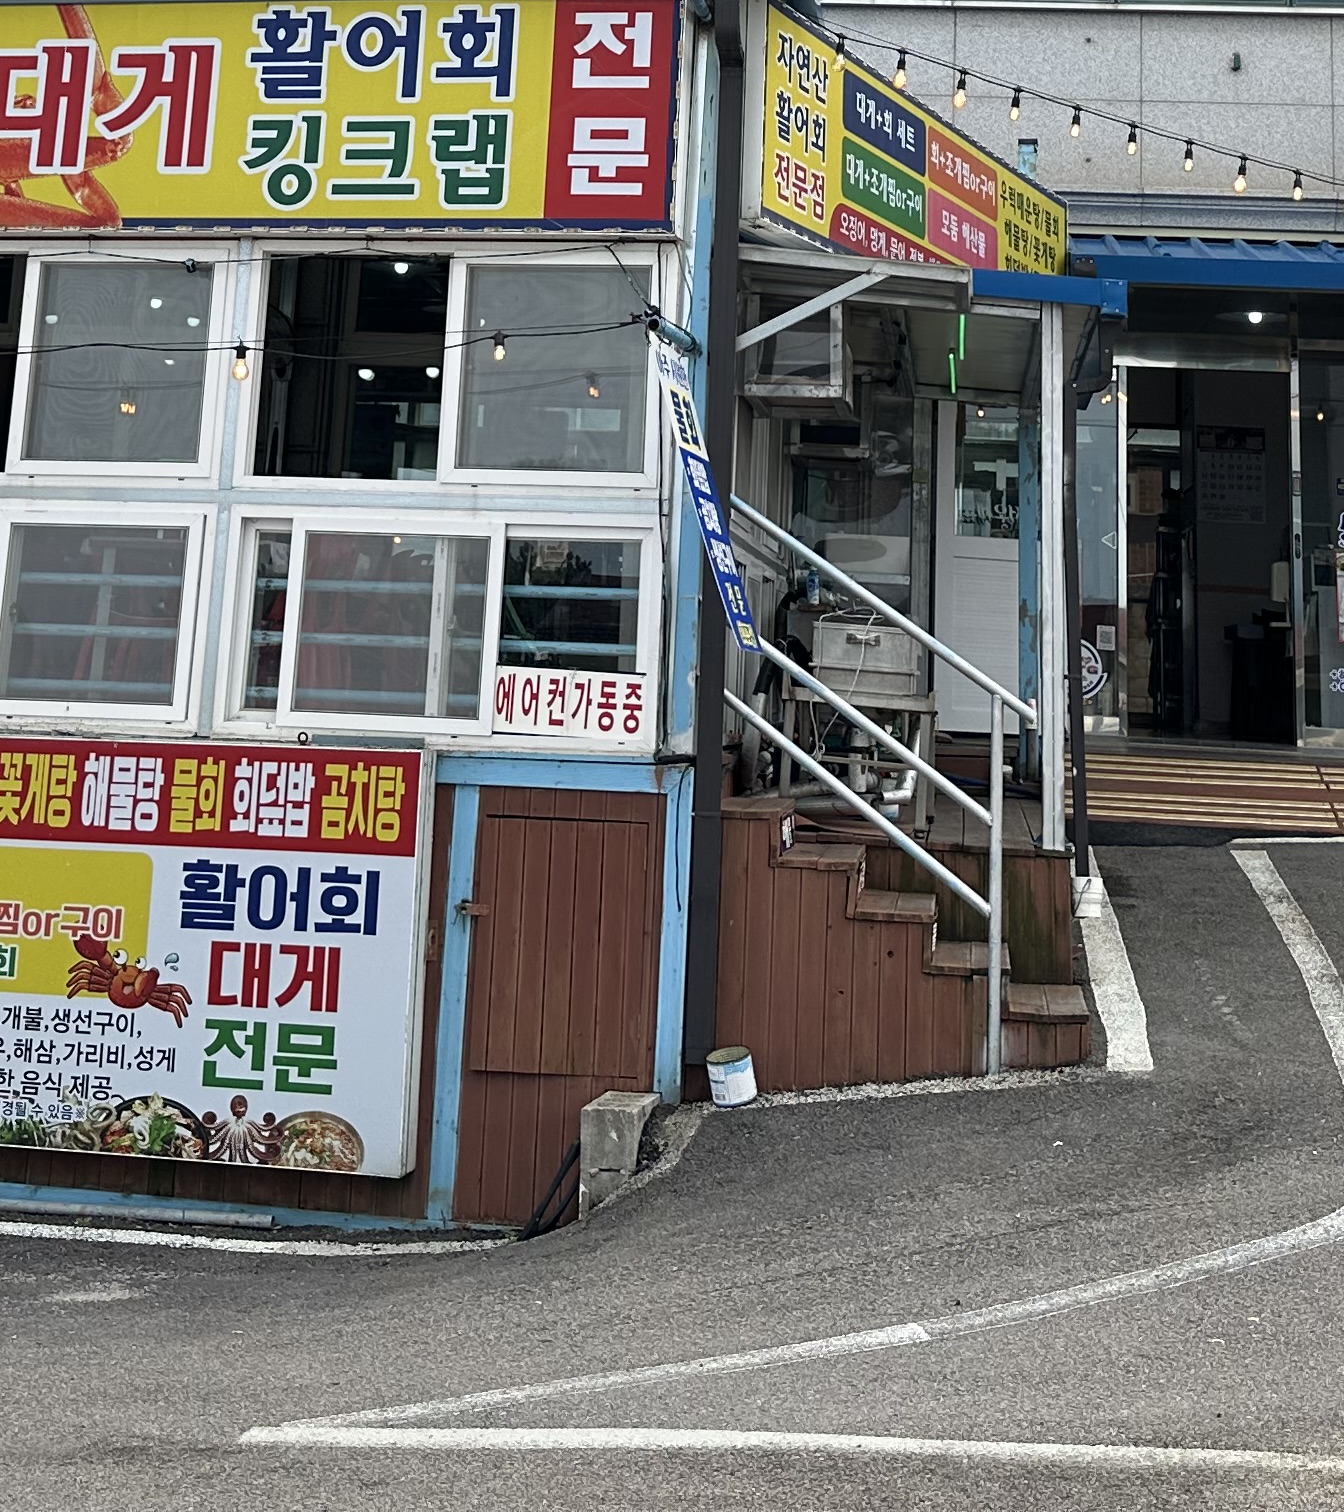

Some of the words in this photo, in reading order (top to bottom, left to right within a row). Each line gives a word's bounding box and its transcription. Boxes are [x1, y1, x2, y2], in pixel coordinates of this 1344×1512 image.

[251, 8, 518, 101] 활어회
[777, 33, 828, 104] 자연산
[568, 12, 653, 195] 전문
[776, 90, 826, 164] 활어회
[856, 92, 892, 140] 대게+회
[897, 119, 915, 152] 세트
[246, 115, 509, 208] 킹크랩
[774, 152, 824, 221] 전문점
[941, 210, 958, 242] 모둠
[962, 221, 986, 258] 해산물
[496, 673, 643, 734] 에어컨가동중
[80, 752, 165, 832] 해물탕
[169, 758, 224, 835] 물회
[229, 760, 315, 838] 회덮밥
[319, 764, 405, 842] 곰치탕
[179, 859, 381, 936] 활어회
[206, 942, 339, 1013] 대게
[20, 1070, 63, 1100] 음식
[69, 1073, 111, 1102] 제공
[201, 1018, 338, 1096] 전문
